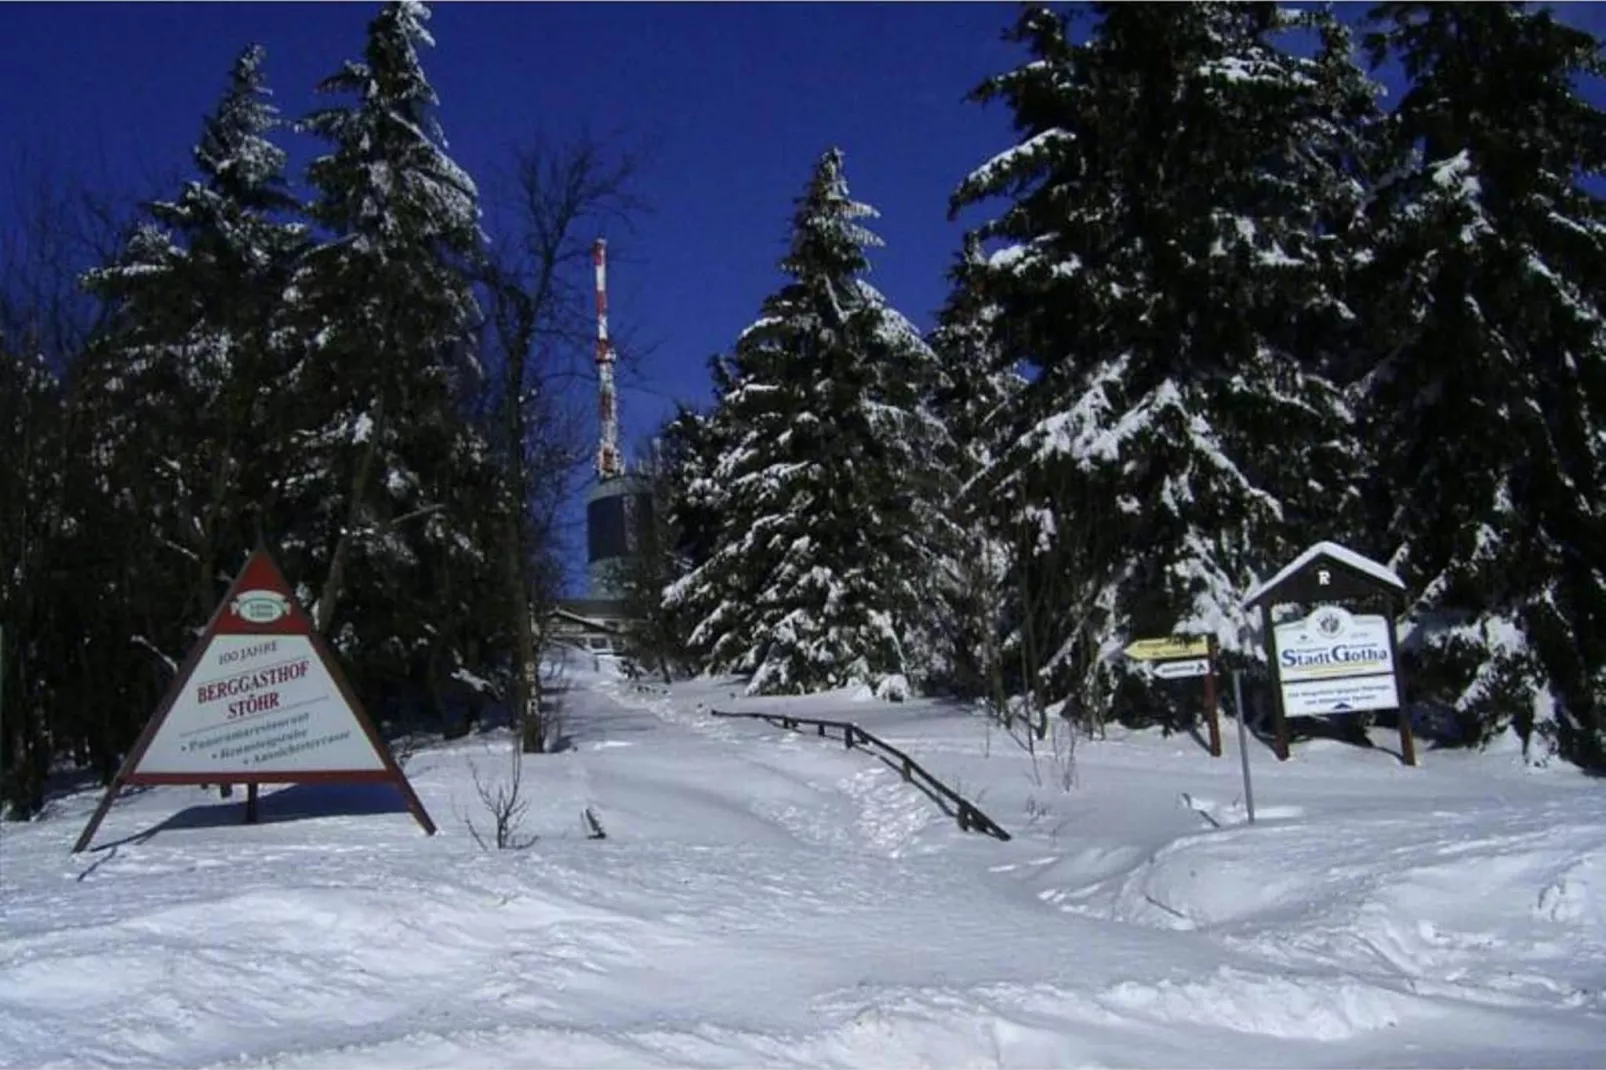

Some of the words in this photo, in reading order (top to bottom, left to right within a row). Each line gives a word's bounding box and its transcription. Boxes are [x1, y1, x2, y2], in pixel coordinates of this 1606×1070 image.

[219, 649, 240, 666] 100
[240, 640, 278, 660] JAHRE
[1332, 644, 1388, 663] Gotha
[197, 660, 309, 704] BERGGASTHOF
[227, 692, 280, 720] STÖHR
